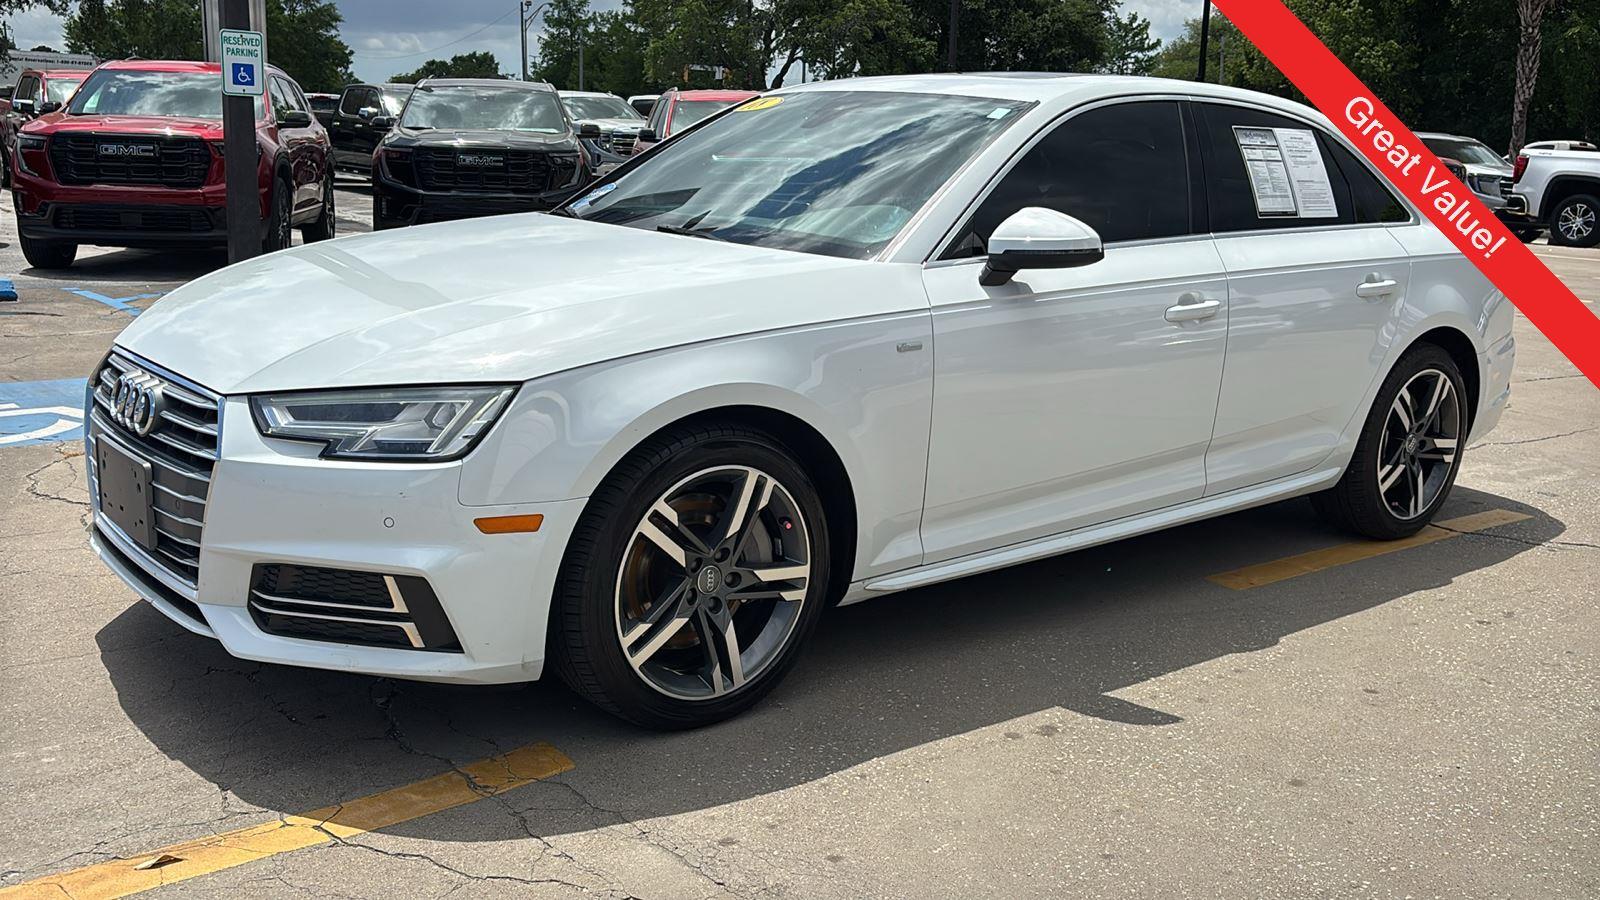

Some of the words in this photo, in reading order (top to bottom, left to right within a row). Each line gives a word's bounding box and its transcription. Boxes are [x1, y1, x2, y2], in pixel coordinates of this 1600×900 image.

[223, 36, 260, 47] RESERVED
[226, 47, 258, 57] PARKING
[100, 144, 153, 156] GMC
[458, 155, 503, 166] GMC
